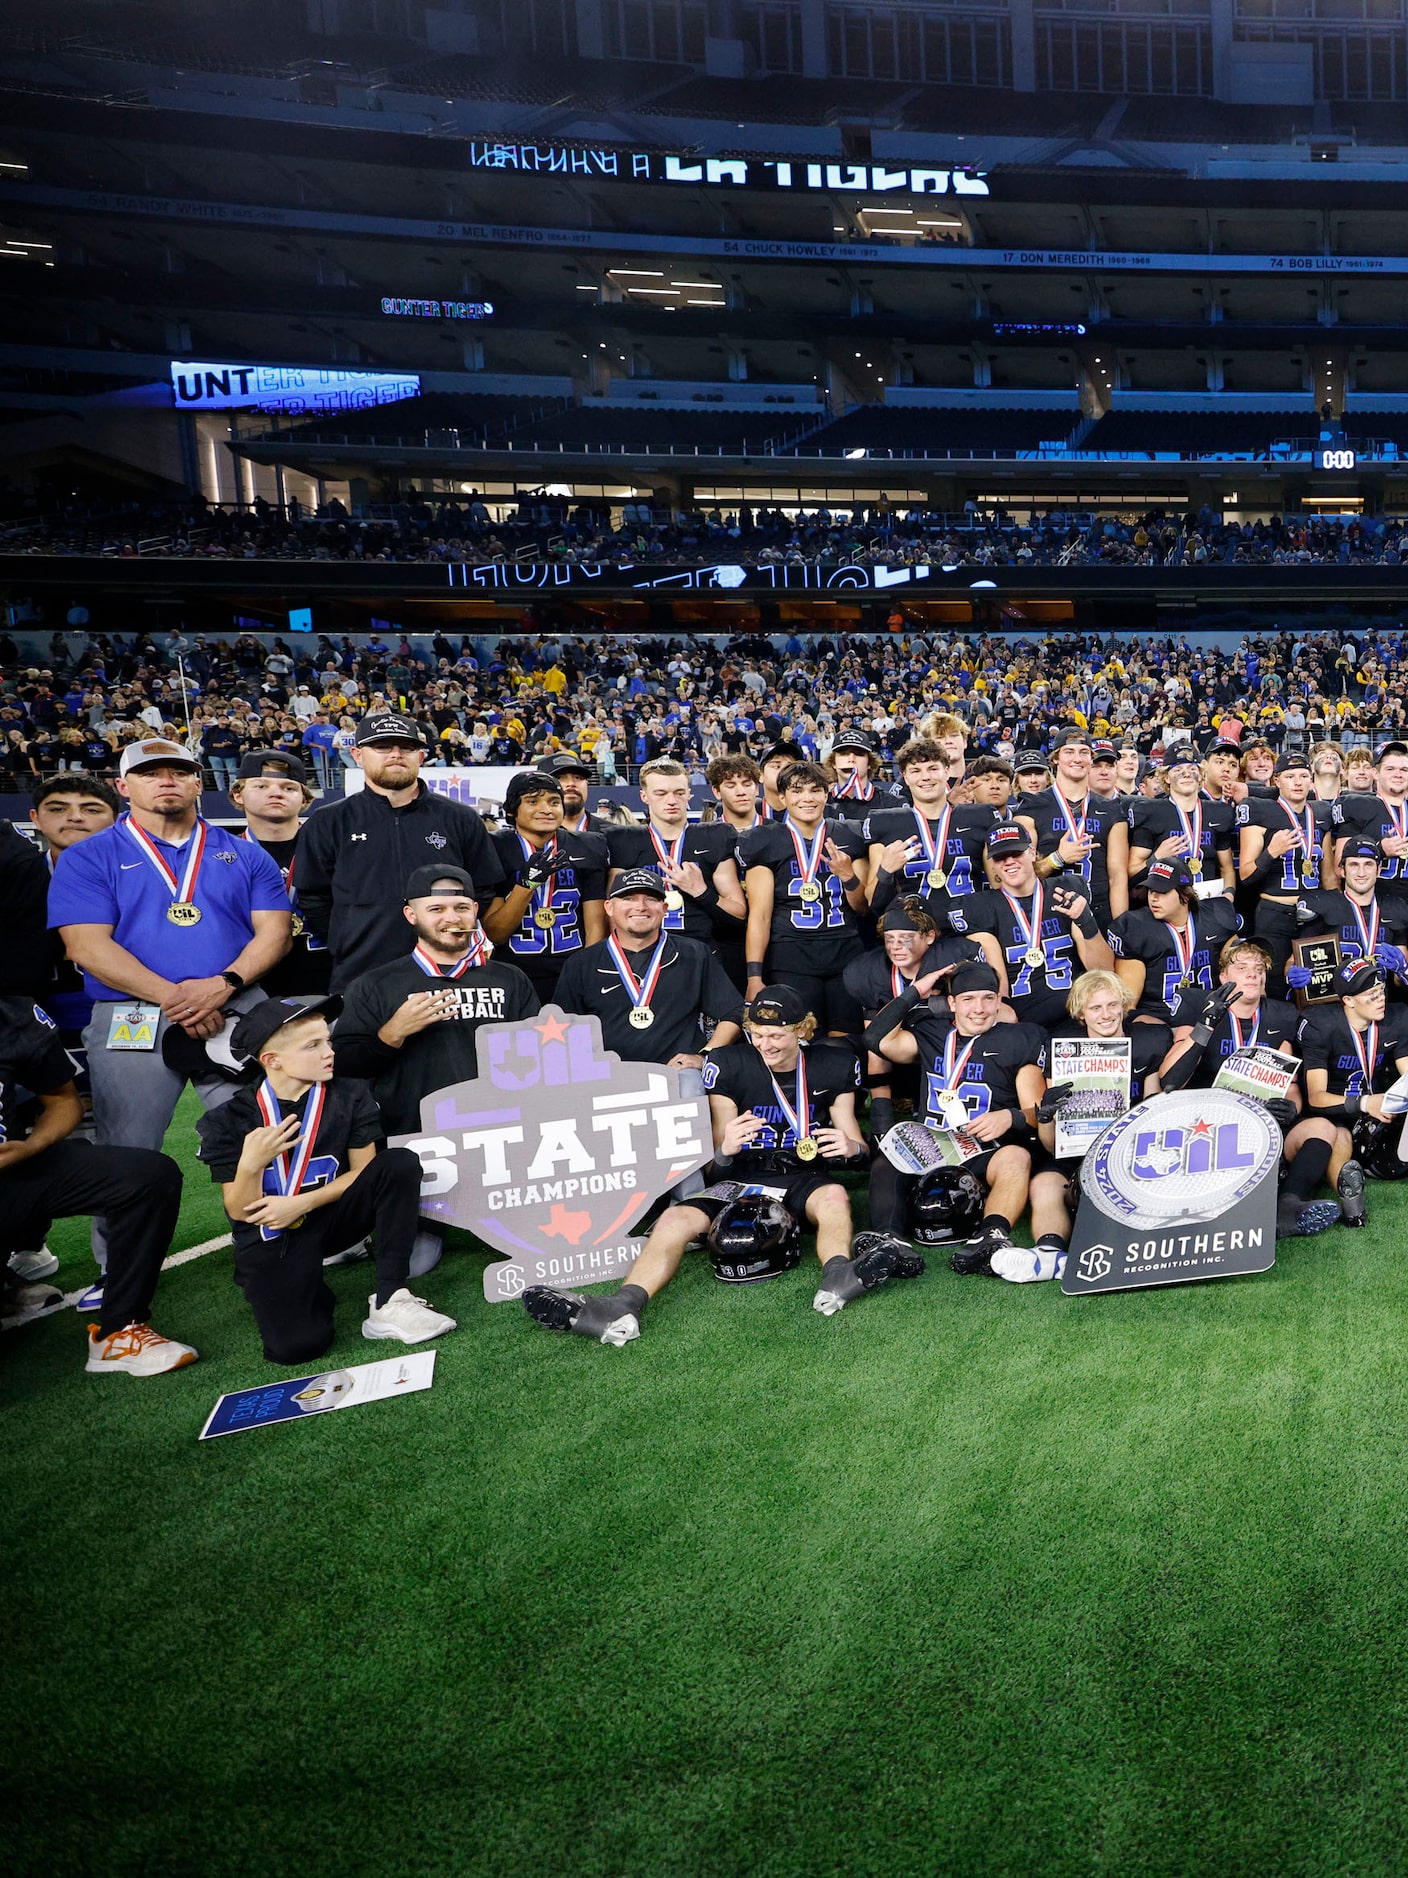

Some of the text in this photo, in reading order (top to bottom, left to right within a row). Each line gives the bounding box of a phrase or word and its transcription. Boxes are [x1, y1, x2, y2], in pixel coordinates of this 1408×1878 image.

[437, 225, 455, 236] 20
[462, 227, 488, 238] MEL
[492, 229, 543, 241] RENFRO
[745, 243, 785, 255] CHUCK
[788, 245, 835, 256] HOWLEY
[1003, 253, 1014, 264] 17
[1020, 253, 1044, 264] DON
[1048, 254, 1104, 265] MEREDITH
[1270, 259, 1283, 269] 74
[1289, 258, 1312, 269] BOB
[1316, 259, 1343, 270] LILLY
[381, 297, 441, 318] GUNTER
[1322, 450, 1354, 469] 0:00
[997, 826, 1019, 836] TEXAS
[903, 856, 974, 899] 74
[788, 877, 847, 930] 31
[508, 888, 585, 955] 32
[1005, 934, 1074, 998] 75
[1311, 972, 1334, 986] MVP
[112, 1024, 153, 1041] AA
[487, 1022, 612, 1091] UIL
[1055, 1059, 1128, 1075] STATE CHAMPS!
[1224, 1057, 1291, 1089] STATE CHAMPS!
[403, 1102, 703, 1197] STATE
[1096, 1105, 1149, 1163] STATE
[1233, 1097, 1281, 1199] CHAMPIONS
[1131, 1119, 1256, 1180] UIL
[487, 1169, 638, 1211] CHAMPIONS
[536, 1243, 642, 1278] SOUTHERN
[1126, 1228, 1263, 1262] SOUTHERN
[599, 1269, 617, 1278] INC.
[1124, 1256, 1225, 1274] RECOGNITION INC.
[228, 1394, 262, 1424] TEXAS
[254, 1387, 286, 1420] PROUD
